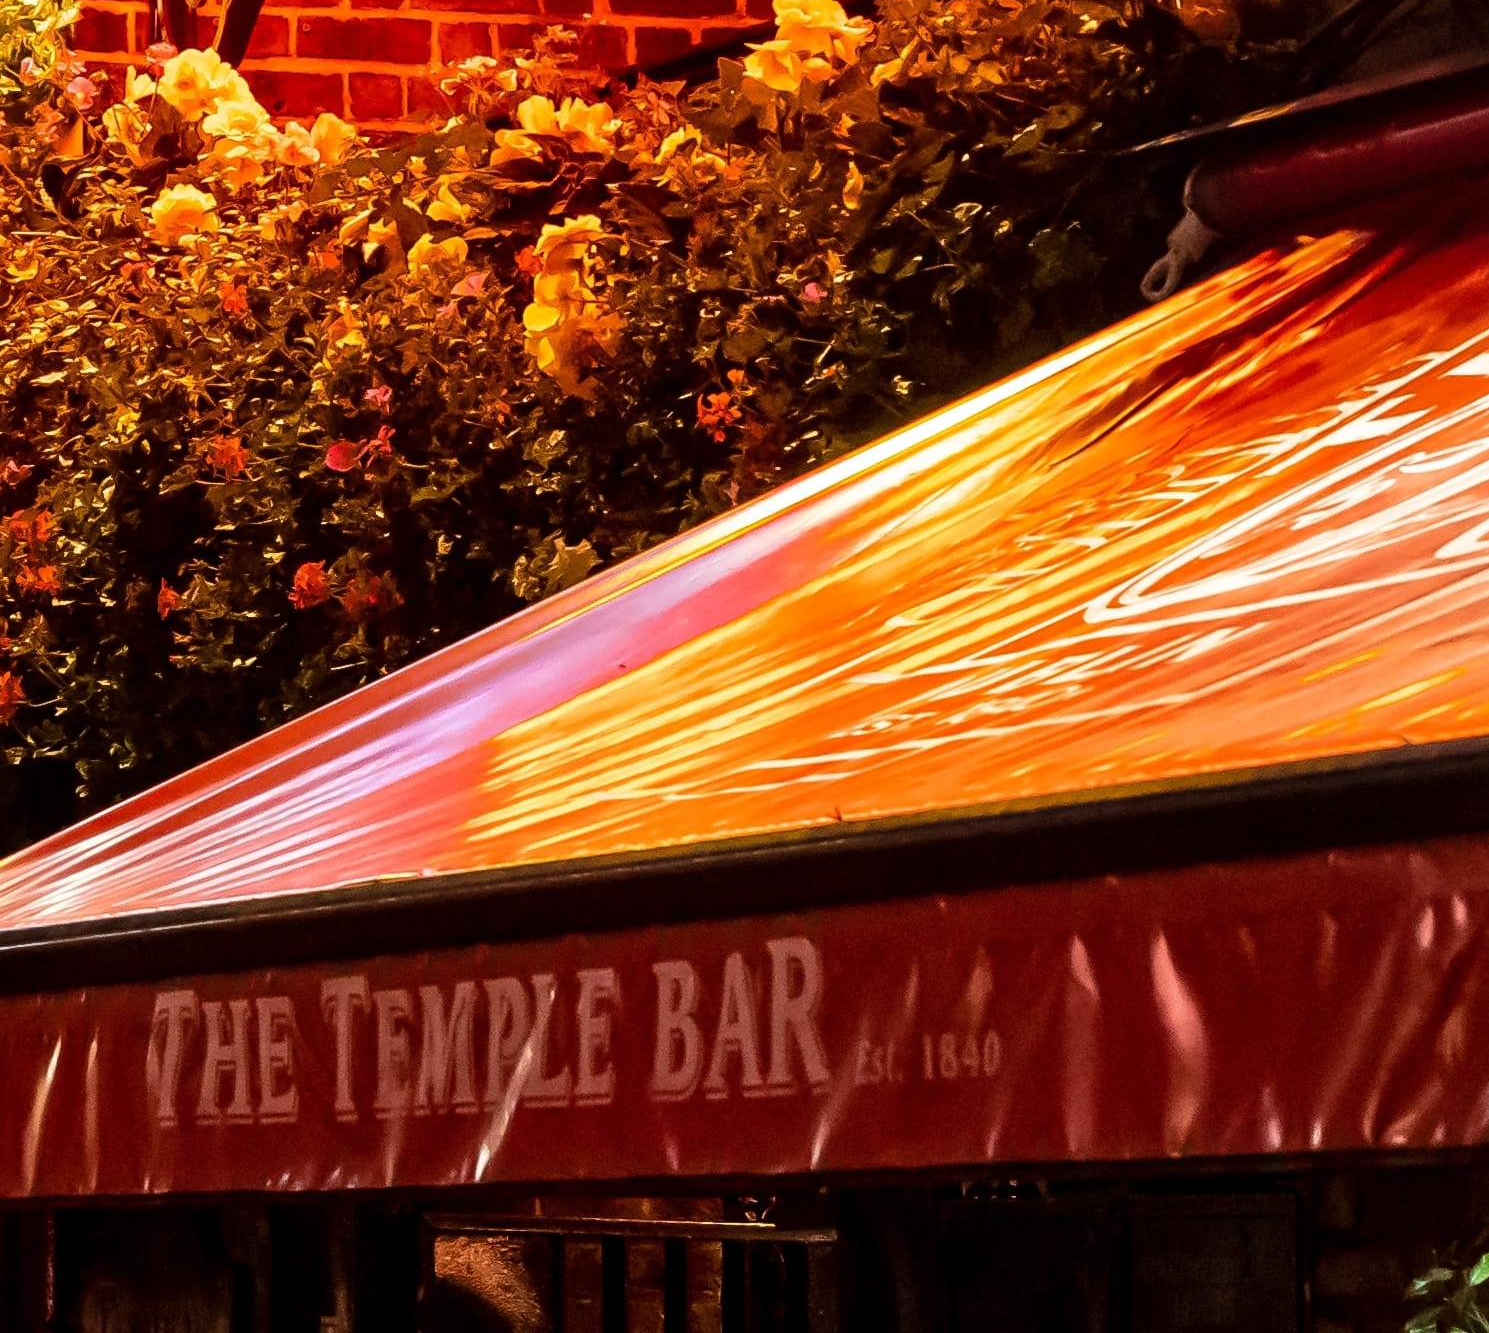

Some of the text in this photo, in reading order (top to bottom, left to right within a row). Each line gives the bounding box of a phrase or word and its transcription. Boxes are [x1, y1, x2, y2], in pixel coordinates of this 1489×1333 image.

[155, 989, 299, 1127] THE
[320, 967, 622, 1123] TEMPLE
[650, 936, 832, 1102] BAR
[923, 1029, 1003, 1081] 1840
